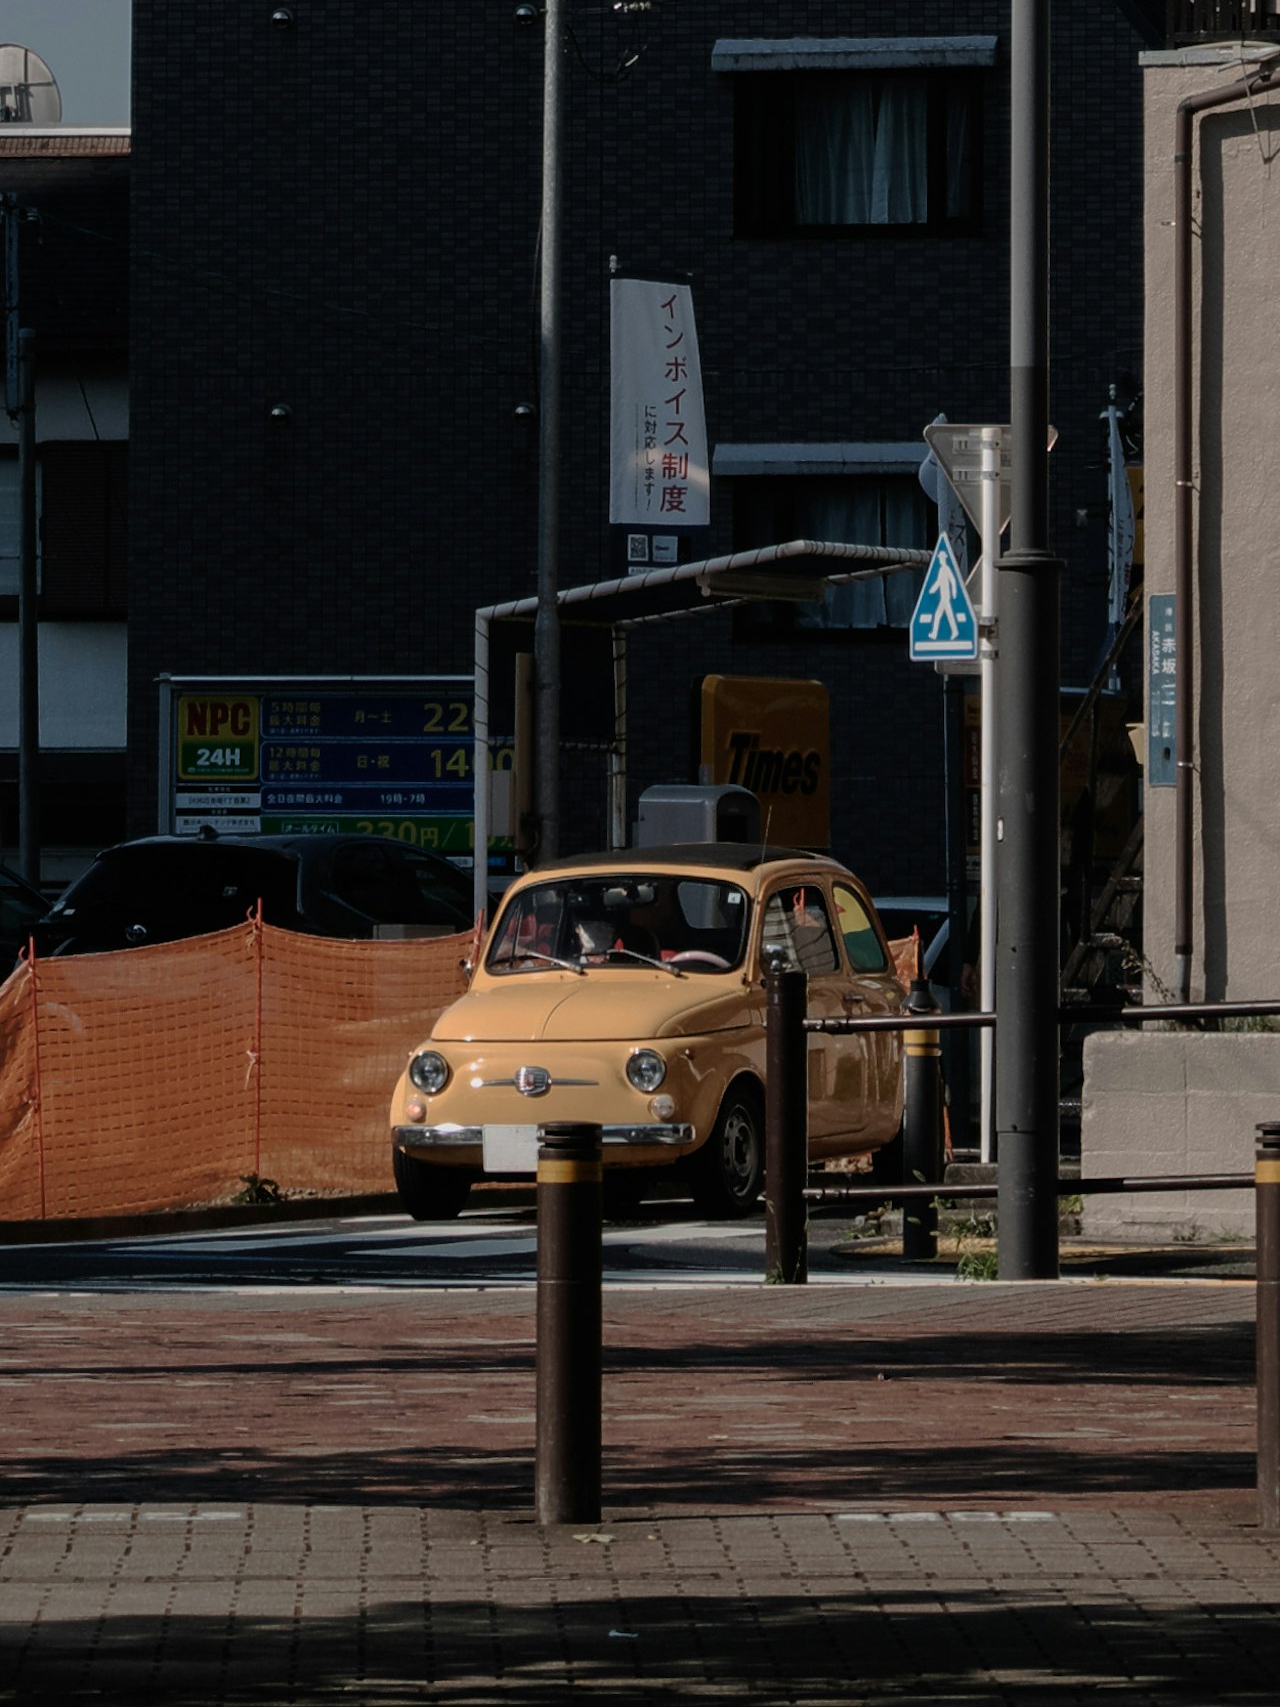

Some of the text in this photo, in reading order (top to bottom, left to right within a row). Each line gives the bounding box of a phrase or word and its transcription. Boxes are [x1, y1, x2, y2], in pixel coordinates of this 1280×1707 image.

[659, 294, 689, 513] インボイス制度
[187, 702, 250, 736] NPC
[196, 747, 241, 766] 24H
[728, 731, 821, 796] Times
